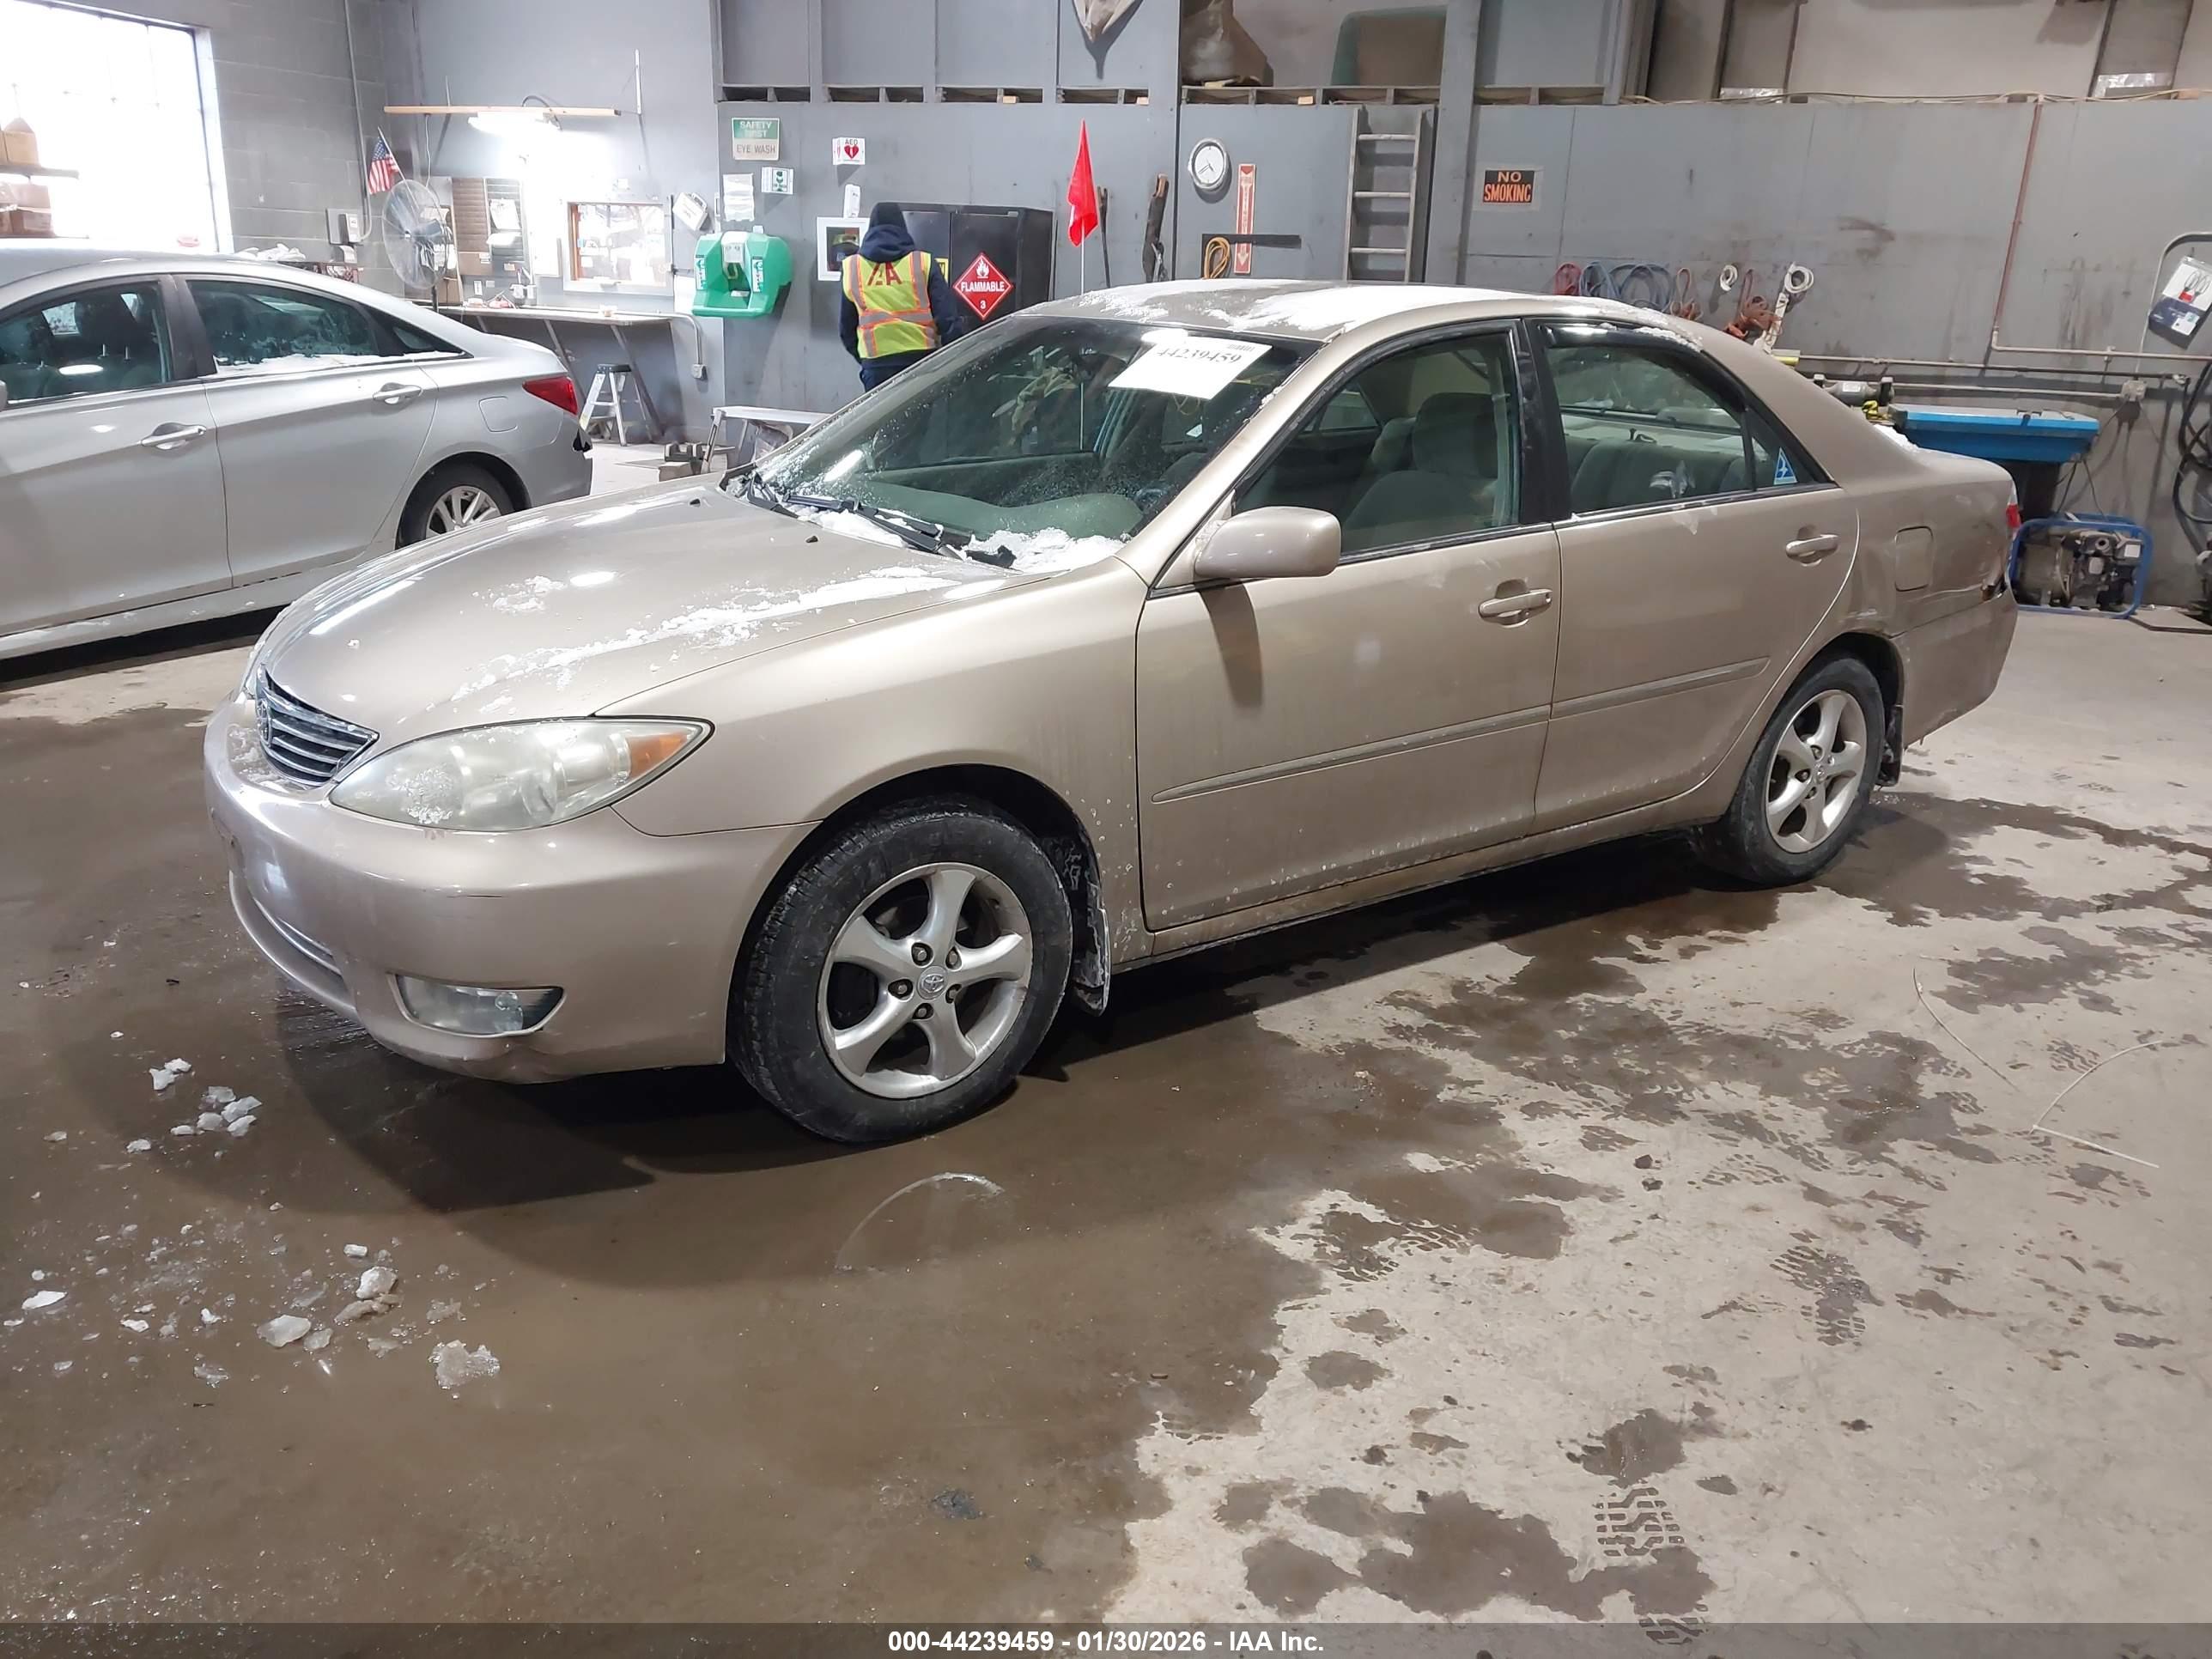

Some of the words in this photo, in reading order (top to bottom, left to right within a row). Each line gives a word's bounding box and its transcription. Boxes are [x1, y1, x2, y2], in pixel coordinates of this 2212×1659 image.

[739, 120, 773, 129] SAFETY
[736, 143, 751, 153] EYE
[754, 143, 776, 154] WASH
[1498, 171, 1522, 183] NO
[1484, 183, 1532, 202] SMOKING
[961, 281, 1006, 293] FLAMMABLE
[980, 300, 987, 310] 3
[1157, 347, 1243, 364] 44239459
